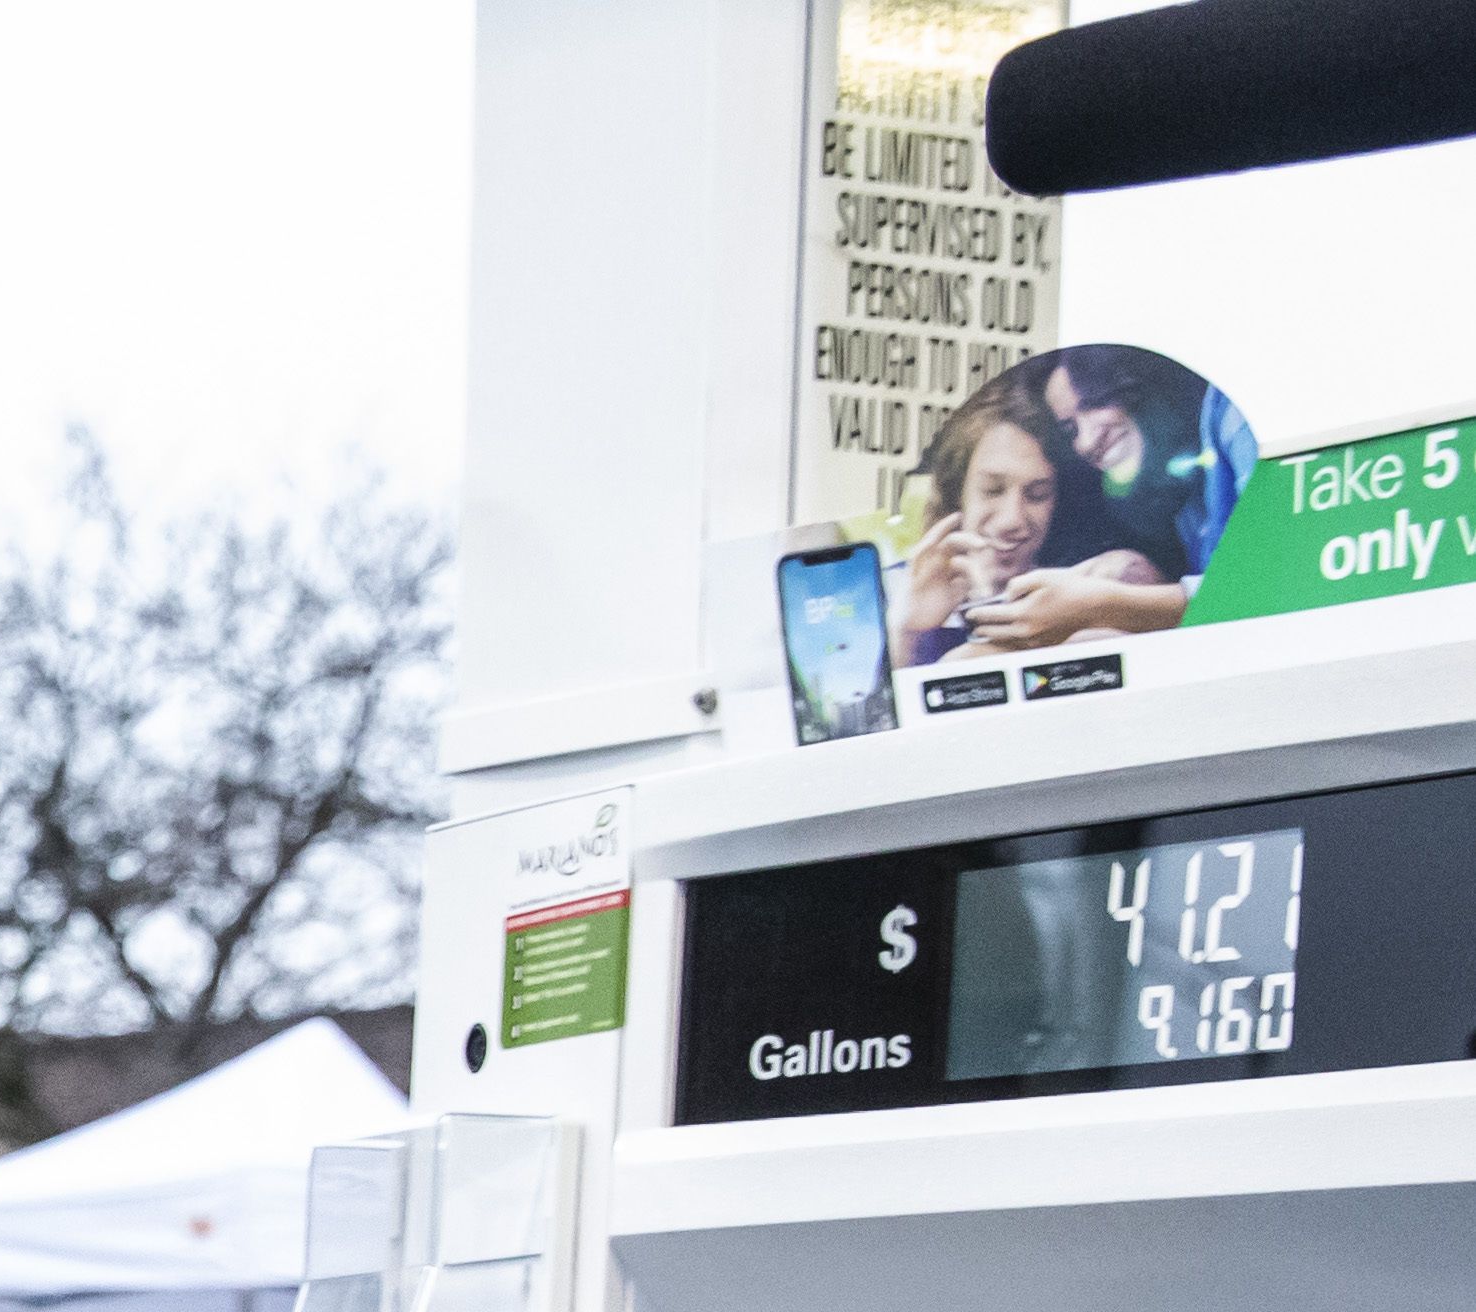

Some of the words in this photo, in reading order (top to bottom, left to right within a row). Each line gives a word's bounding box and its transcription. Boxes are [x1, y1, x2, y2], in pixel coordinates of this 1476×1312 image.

[820, 120, 854, 179] BE
[863, 126, 972, 191] LIMITED
[836, 191, 999, 263] SUPERVISED
[847, 260, 971, 327] PERSONS
[980, 275, 1035, 333] OLD
[816, 325, 919, 390] ENOUGH
[926, 337, 960, 394] TO
[828, 392, 906, 454] VALID
[1279, 446, 1406, 514] Take
[1422, 427, 1460, 490] 5
[1319, 508, 1446, 581] only
[877, 904, 918, 973] $
[749, 1029, 913, 1081] Gallons
